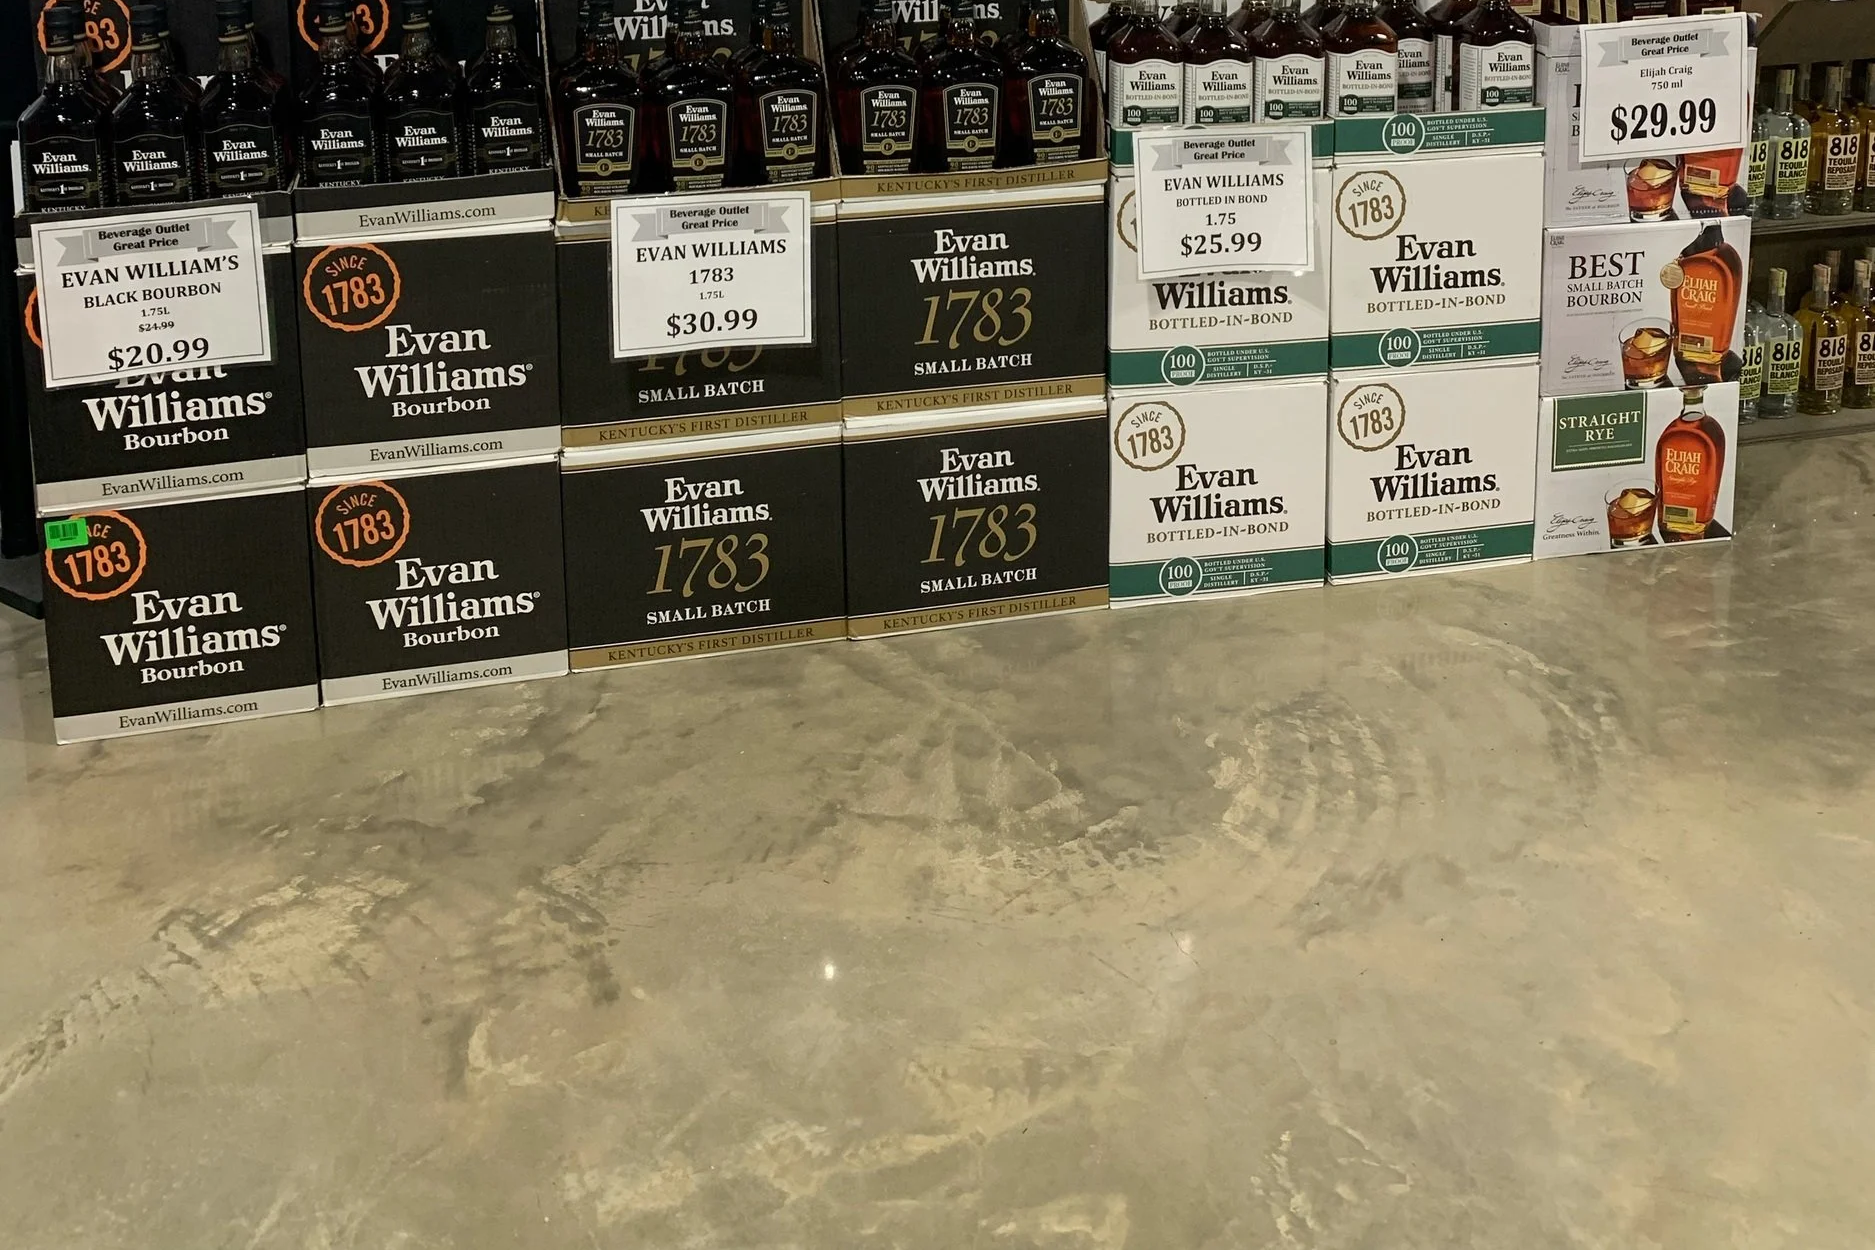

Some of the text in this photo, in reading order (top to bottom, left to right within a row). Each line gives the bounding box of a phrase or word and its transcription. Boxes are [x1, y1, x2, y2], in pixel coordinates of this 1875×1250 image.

[1631, 32, 1699, 46] Beverage Outlet
[1641, 45, 1689, 57] Great Price
[1355, 60, 1384, 71] Evan
[1640, 65, 1693, 78] Elijah Craig
[1044, 79, 1068, 89] Evan
[1652, 79, 1683, 90] 750 ml
[1039, 97, 1074, 116] 1783
[1610, 98, 1716, 145] $29.99
[1183, 138, 1256, 152] Beverage Outlet
[1193, 149, 1246, 161] Great Price
[1780, 140, 1809, 160] 818
[1778, 169, 1806, 178] BLANCO
[1779, 161, 1807, 170] TEQUILA
[1163, 172, 1285, 193] EVAN WILLIAMS
[1352, 179, 1383, 197] SINCE
[1176, 193, 1268, 208] BOTTLED IN BOND
[669, 205, 750, 220] Beverage Outlet
[1205, 212, 1237, 226] 1.75
[1348, 194, 1395, 229] 1783
[98, 221, 190, 242] Beverage Outlet
[681, 217, 739, 231] Great Price
[113, 236, 179, 253] Great Price
[635, 238, 787, 264] EVAN WILLIAMS
[933, 229, 1010, 256] Evan
[1180, 231, 1263, 258] $25.99
[1395, 233, 1477, 261] Evan
[61, 254, 240, 290] EVAN WILLIAM'S
[324, 254, 368, 278] SINCE
[688, 266, 735, 286] 1783
[1568, 251, 1645, 280] BEST
[83, 281, 222, 310] BLACK BOURBON
[321, 273, 386, 317] 1783
[699, 290, 725, 301] 1.75L
[1567, 279, 1644, 293] SMALL BATCH
[1367, 293, 1507, 314] BOTTLED-IN-BOND
[1567, 291, 1643, 308] BOURBON
[140, 305, 170, 318] 1.75L
[913, 286, 1034, 351] 1783
[1148, 311, 1293, 333] BOTTLED-IN-BOND
[666, 307, 759, 339] $30.99
[384, 324, 491, 359] Evan
[1820, 338, 1845, 358] 818
[107, 336, 210, 373] $20.99
[914, 353, 1033, 377] SMALL BATCH
[1818, 357, 1844, 367] TEQUILA
[391, 395, 491, 419] Bourbon
[1559, 410, 1641, 430] STRAIGHT
[123, 424, 229, 452] Bourbon
[1584, 427, 1615, 442] RYE
[940, 448, 1014, 475] Evan
[1666, 448, 1702, 463] ELIJAH
[1175, 463, 1258, 491] Evan
[1665, 460, 1700, 475] CRAIG
[664, 476, 744, 505] Evan
[920, 503, 1038, 568] 1783
[1146, 520, 1290, 544] BOTTLED-IN-BOND
[1543, 531, 1575, 541] Greatness
[63, 539, 131, 587] 1783
[646, 533, 771, 599] 1783
[1168, 564, 1192, 580] 100
[1225, 563, 1265, 571] SUPERVISION
[920, 568, 1037, 594] SMALL BATCH
[131, 588, 243, 626] Evan
[646, 599, 771, 626] SMALL BATCH
[608, 627, 815, 662] KENTUCKY'S FIRST DISTILLER
[140, 656, 245, 685] Bourbon
[118, 700, 259, 730] EvanWilliams.com
